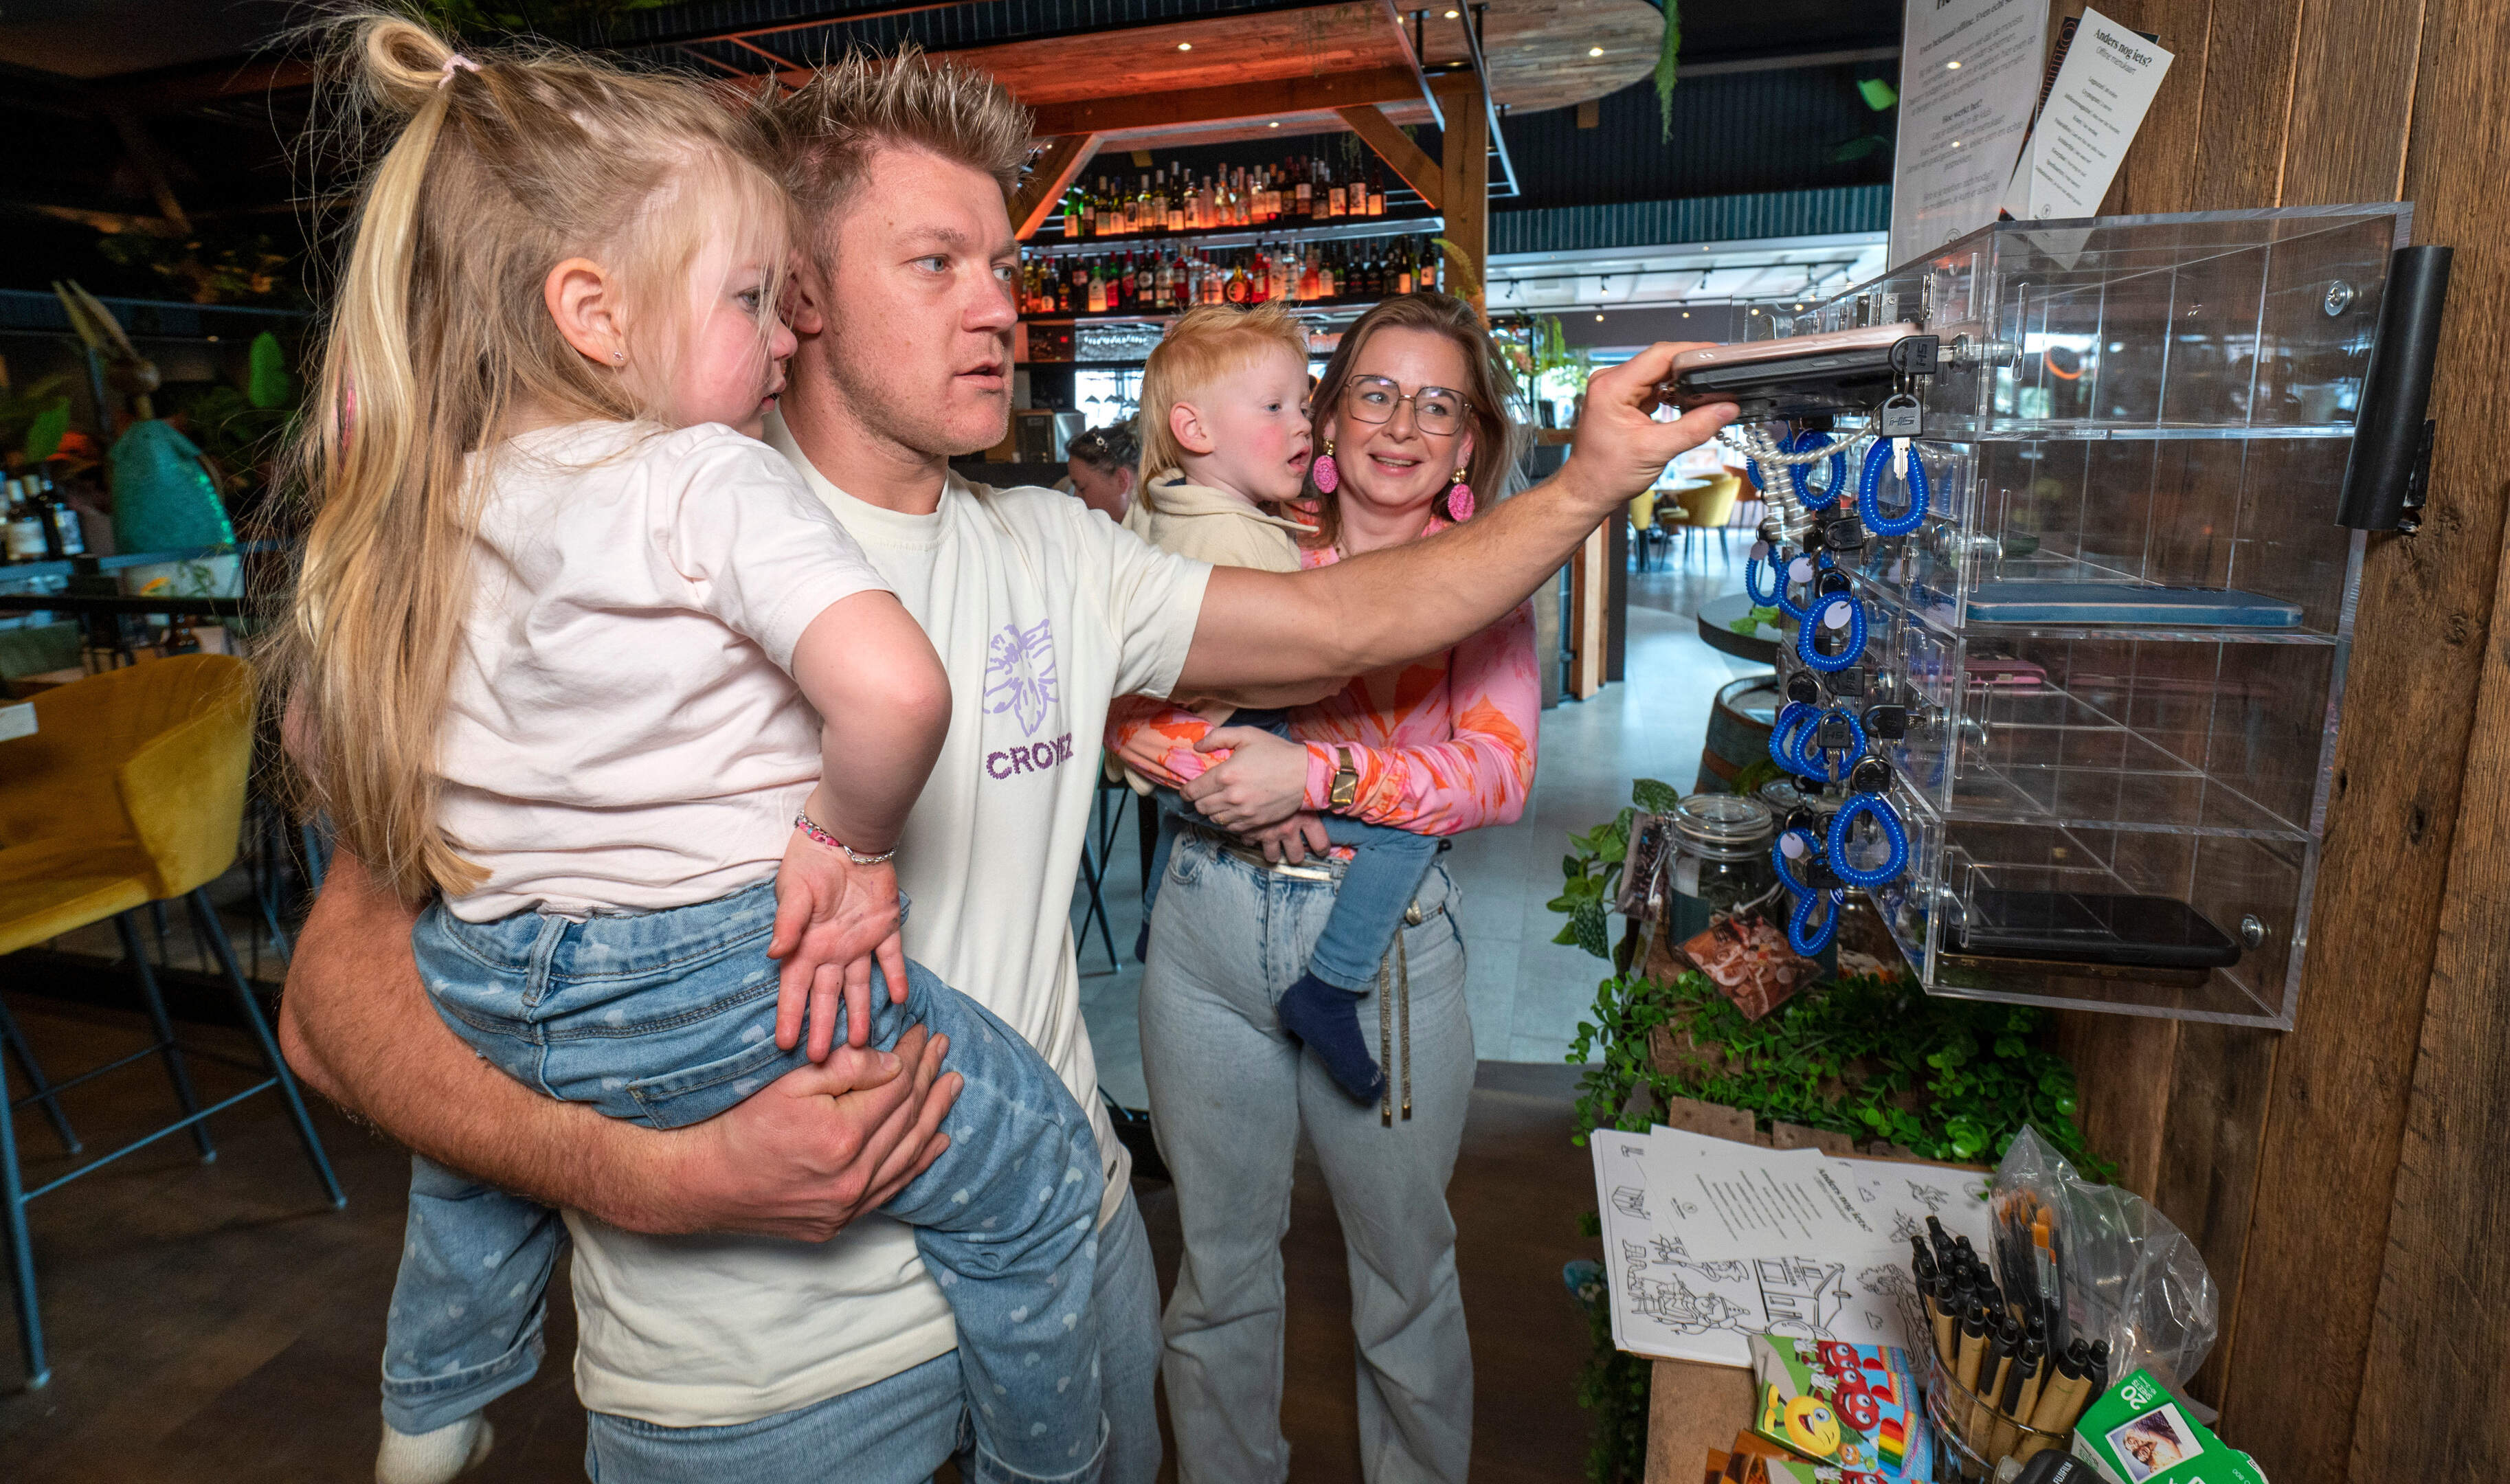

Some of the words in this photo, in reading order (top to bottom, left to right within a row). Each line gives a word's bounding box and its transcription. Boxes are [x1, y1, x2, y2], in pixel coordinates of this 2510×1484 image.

[2094, 28, 2119, 49] Anders
[2118, 44, 2133, 60] nog
[2132, 49, 2152, 67] iets?
[1890, 416, 1915, 427] HS
[986, 732, 1073, 780] CROYEZ
[2120, 1385, 2148, 1410] 20
[2131, 1379, 2153, 1401] SHEETS
[2053, 1461, 2073, 1484] FUJIFILM
